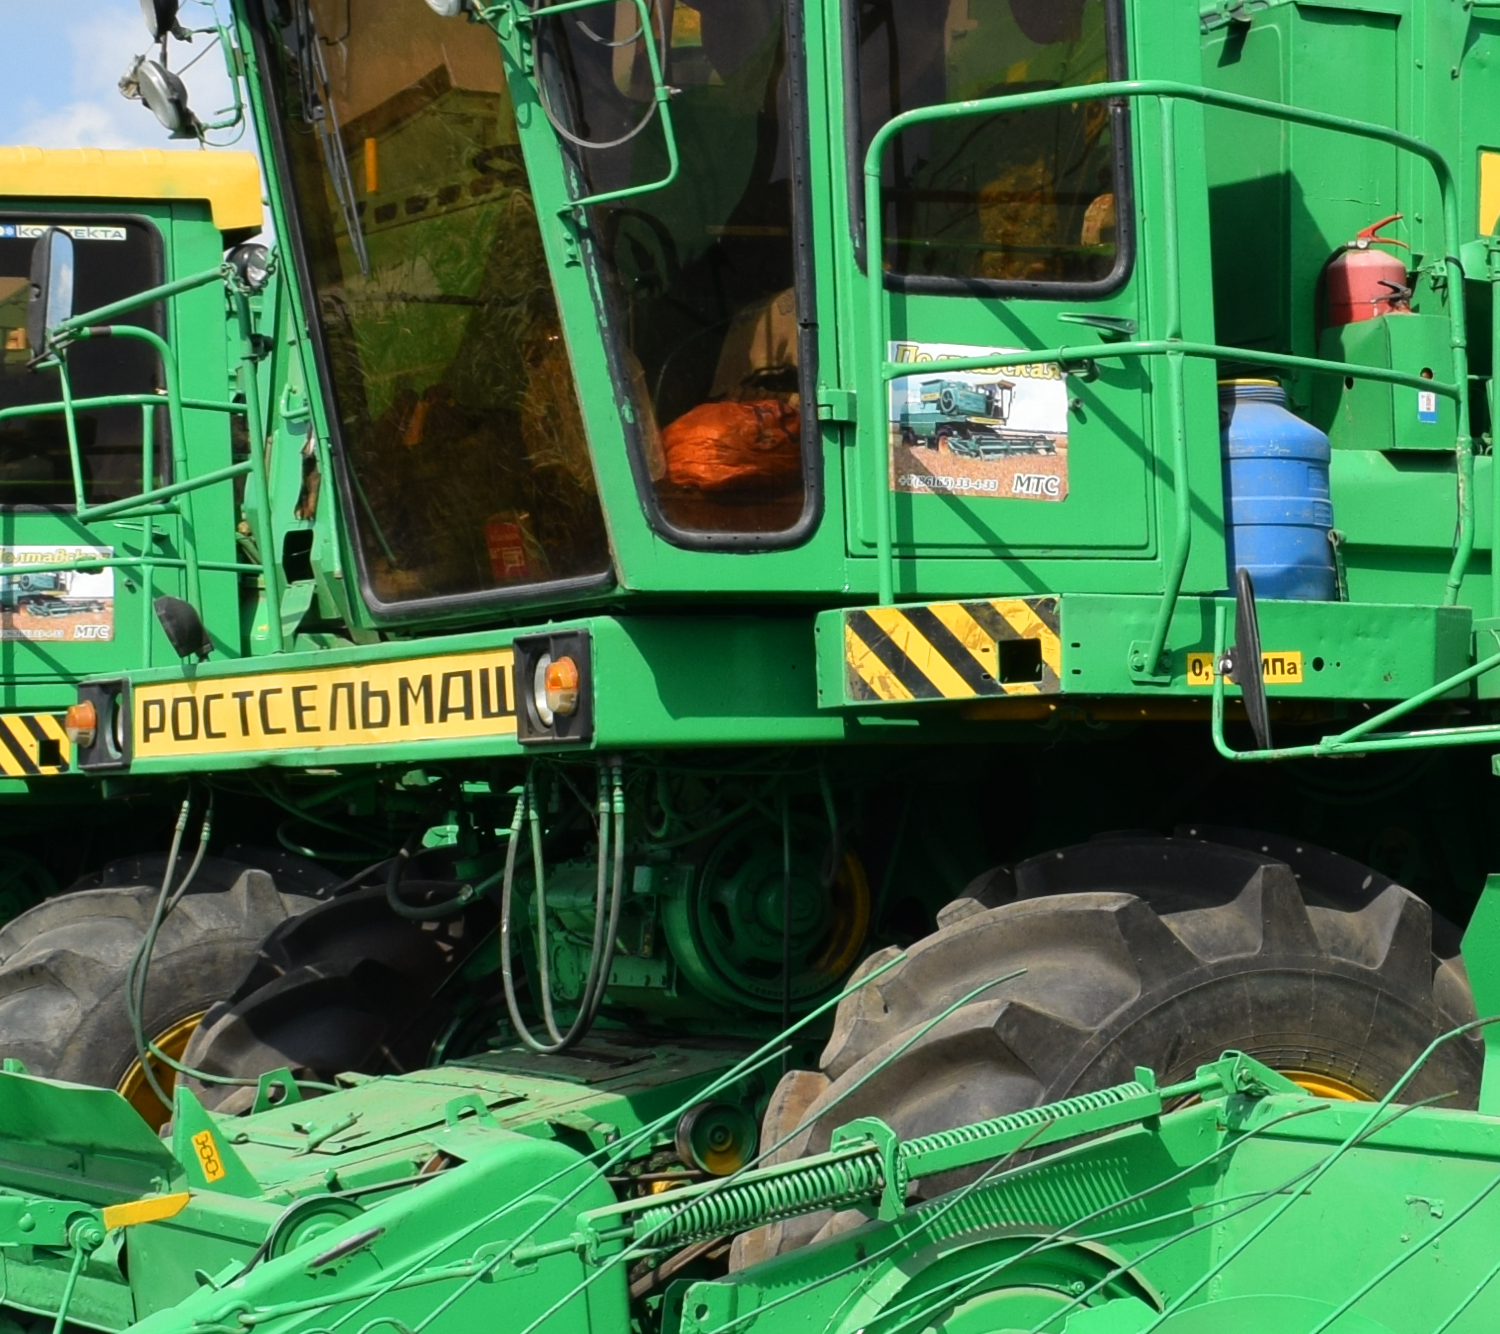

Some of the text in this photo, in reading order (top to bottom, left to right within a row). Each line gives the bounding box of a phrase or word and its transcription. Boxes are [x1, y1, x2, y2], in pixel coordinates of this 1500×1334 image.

[20, 228, 124, 239] KOEKTA
[1013, 473, 1060, 494] МТС
[74, 625, 109, 639] МТС
[143, 664, 516, 743] РОСТСЕЛЬМАШ
